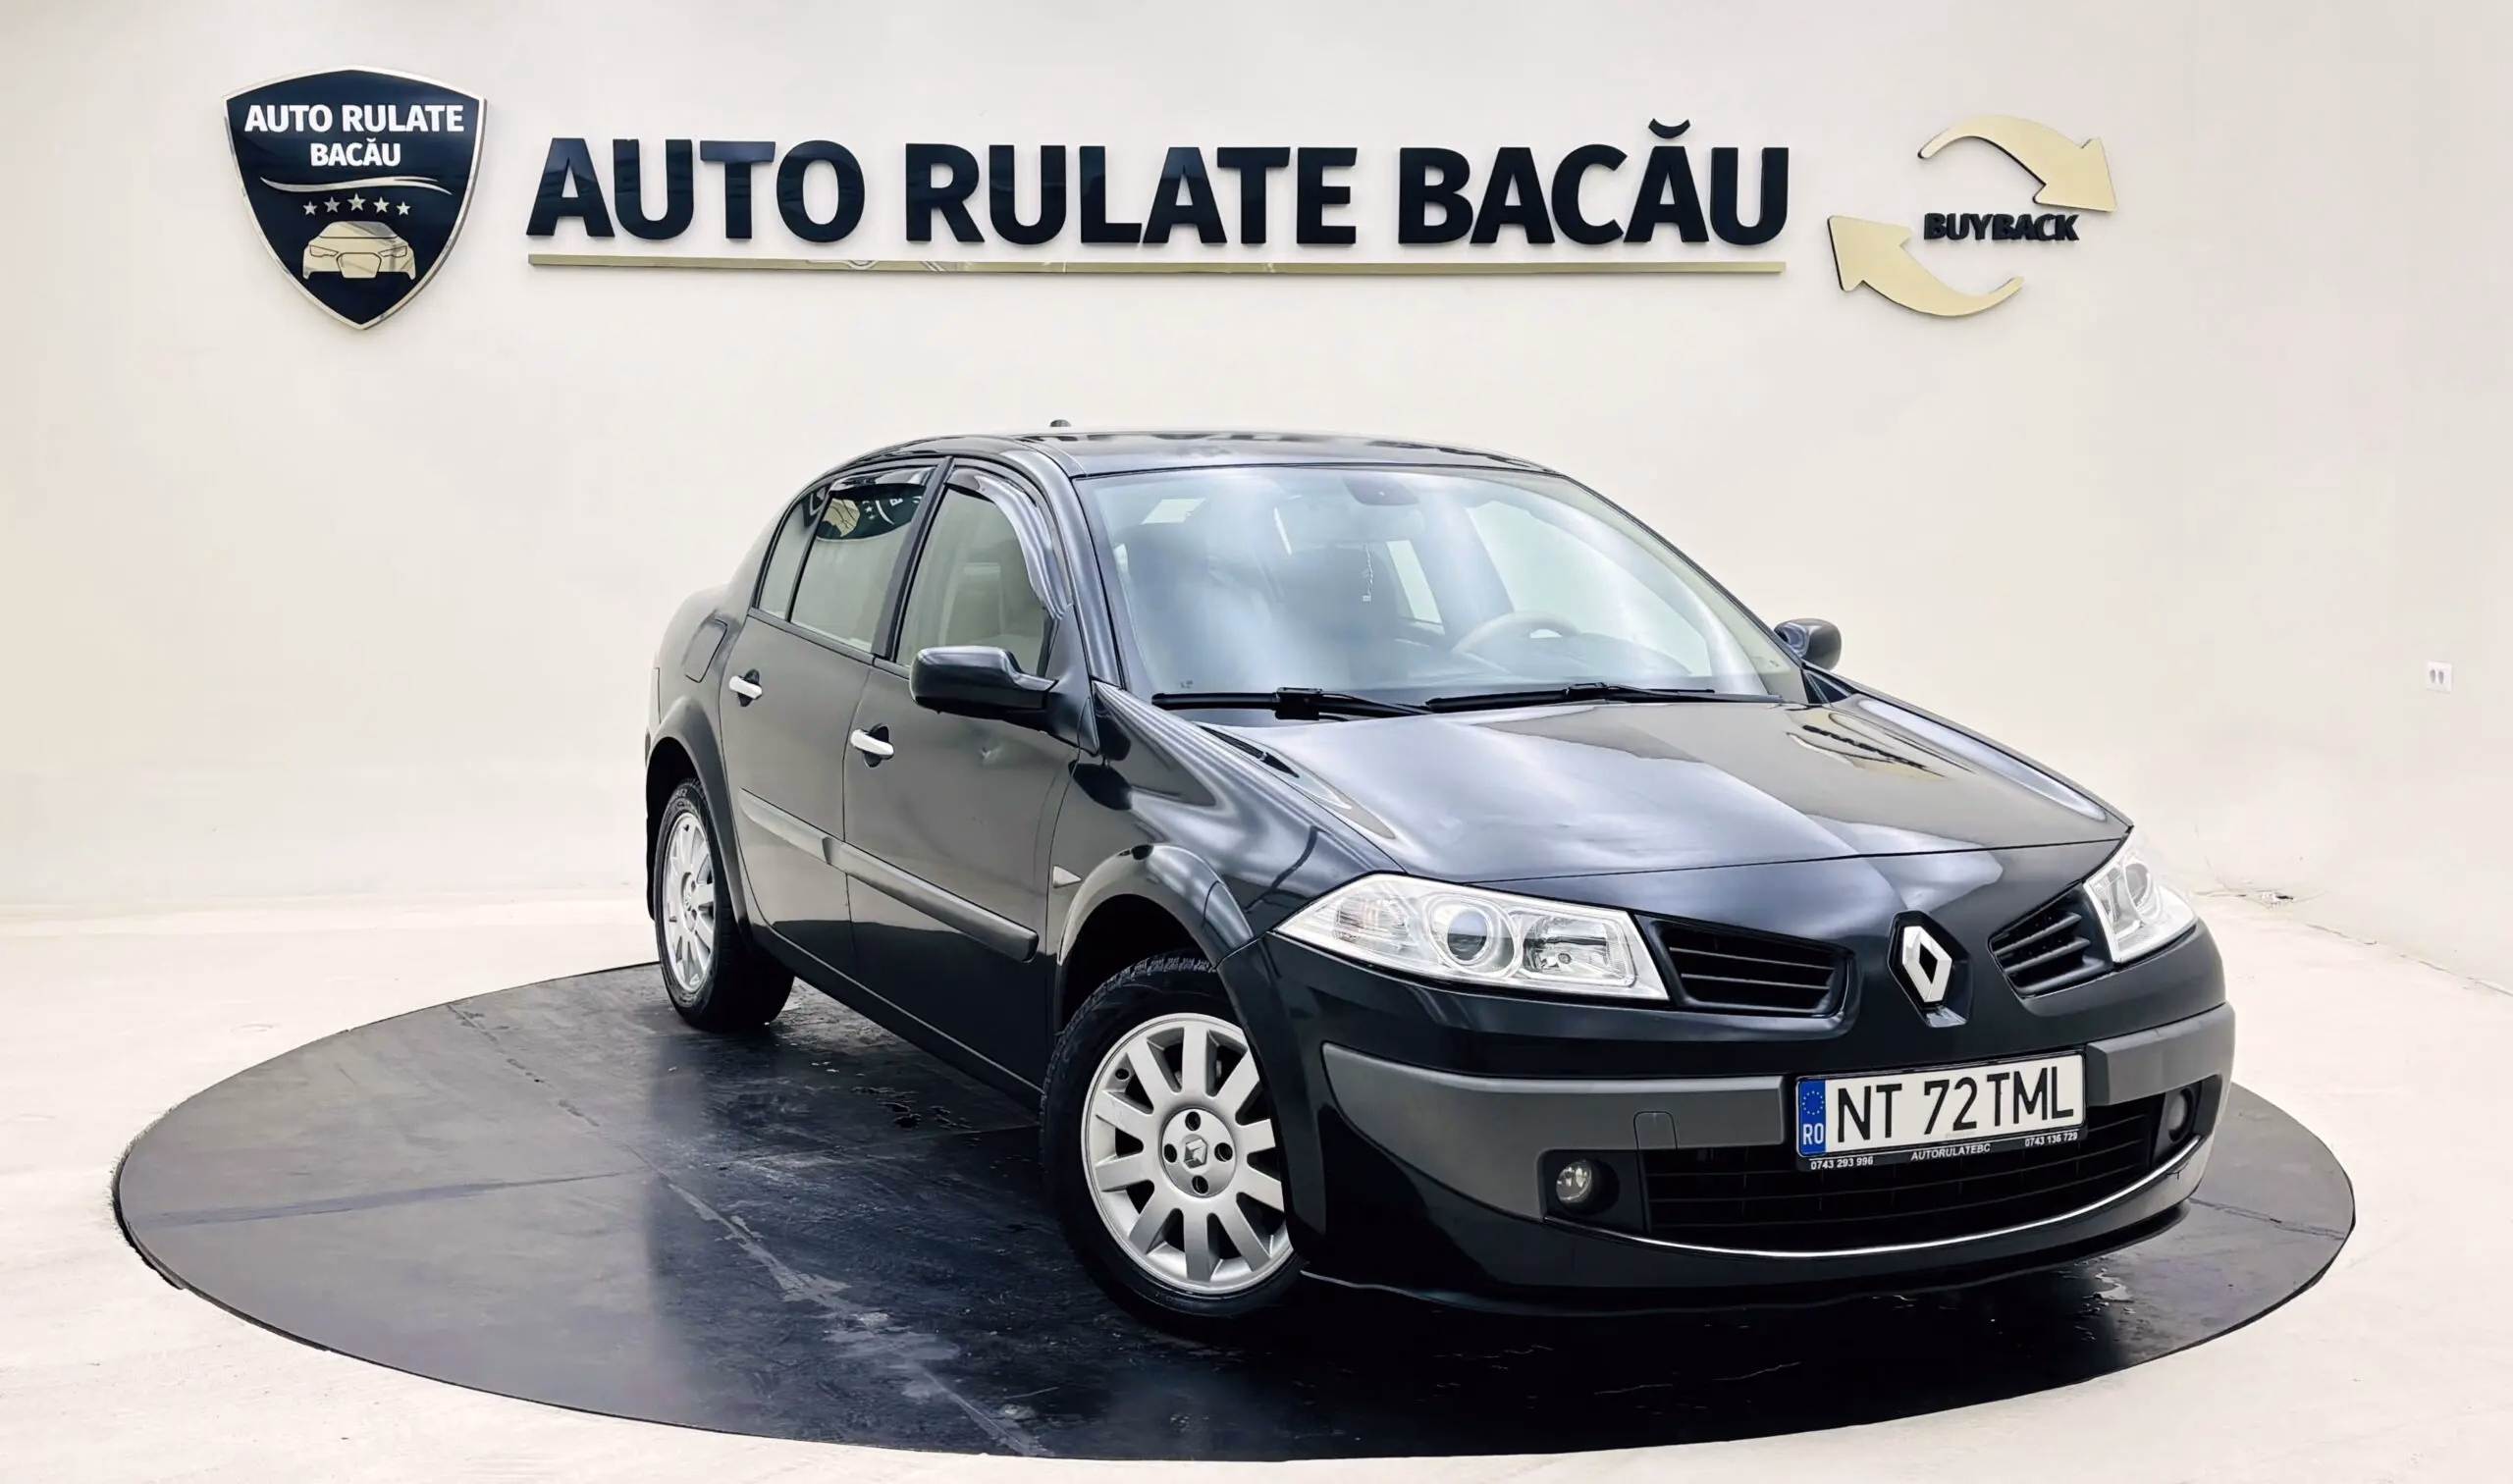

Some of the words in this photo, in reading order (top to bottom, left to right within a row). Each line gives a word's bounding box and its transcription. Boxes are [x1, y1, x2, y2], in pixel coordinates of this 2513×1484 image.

[244, 104, 333, 132] AUTO
[342, 104, 464, 132] RULATE
[310, 137, 401, 167] BACĂU
[525, 137, 866, 243] AUTO
[905, 142, 1359, 246] RULATE
[1398, 118, 1791, 246] BACĂU
[1923, 212, 2080, 241] BUYBACK
[1837, 1083, 1902, 1143] NT
[1923, 1077, 1978, 1136] 72
[1986, 1066, 2074, 1127] TML
[1802, 1123, 1825, 1145] RO
[2024, 1137, 2045, 1147] 0743
[1810, 1159, 1835, 1171] 0743
[1837, 1157, 1854, 1169] 293
[1910, 1142, 1991, 1161] AUTORULATEBC
